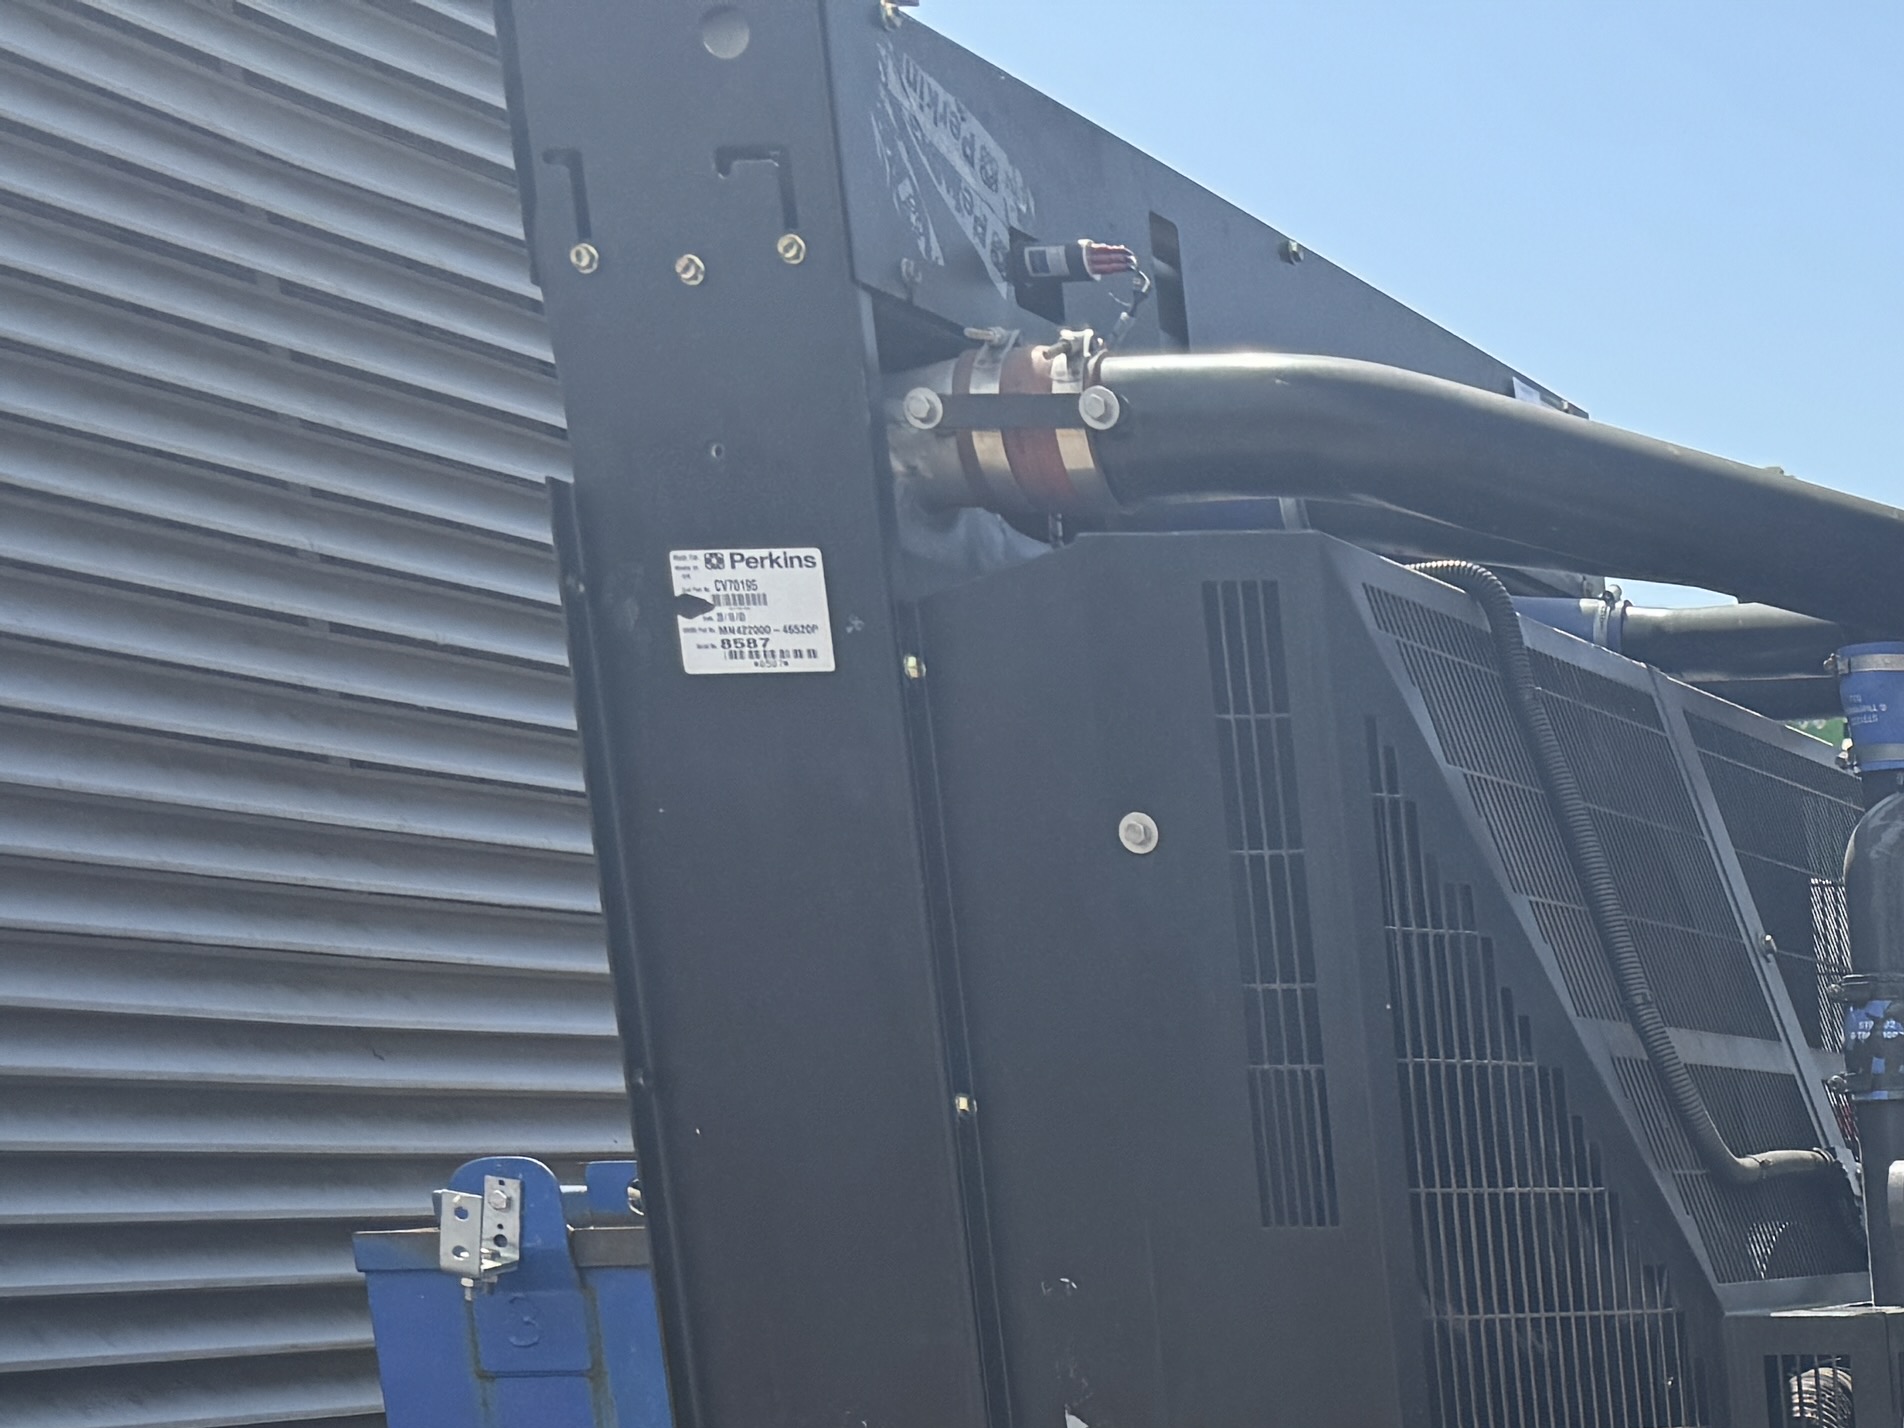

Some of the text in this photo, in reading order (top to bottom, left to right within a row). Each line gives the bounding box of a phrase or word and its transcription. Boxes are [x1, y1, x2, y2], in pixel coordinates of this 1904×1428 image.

[903, 55, 976, 171] Perkin
[729, 551, 817, 570] Perkins
[720, 637, 770, 649] 8587
